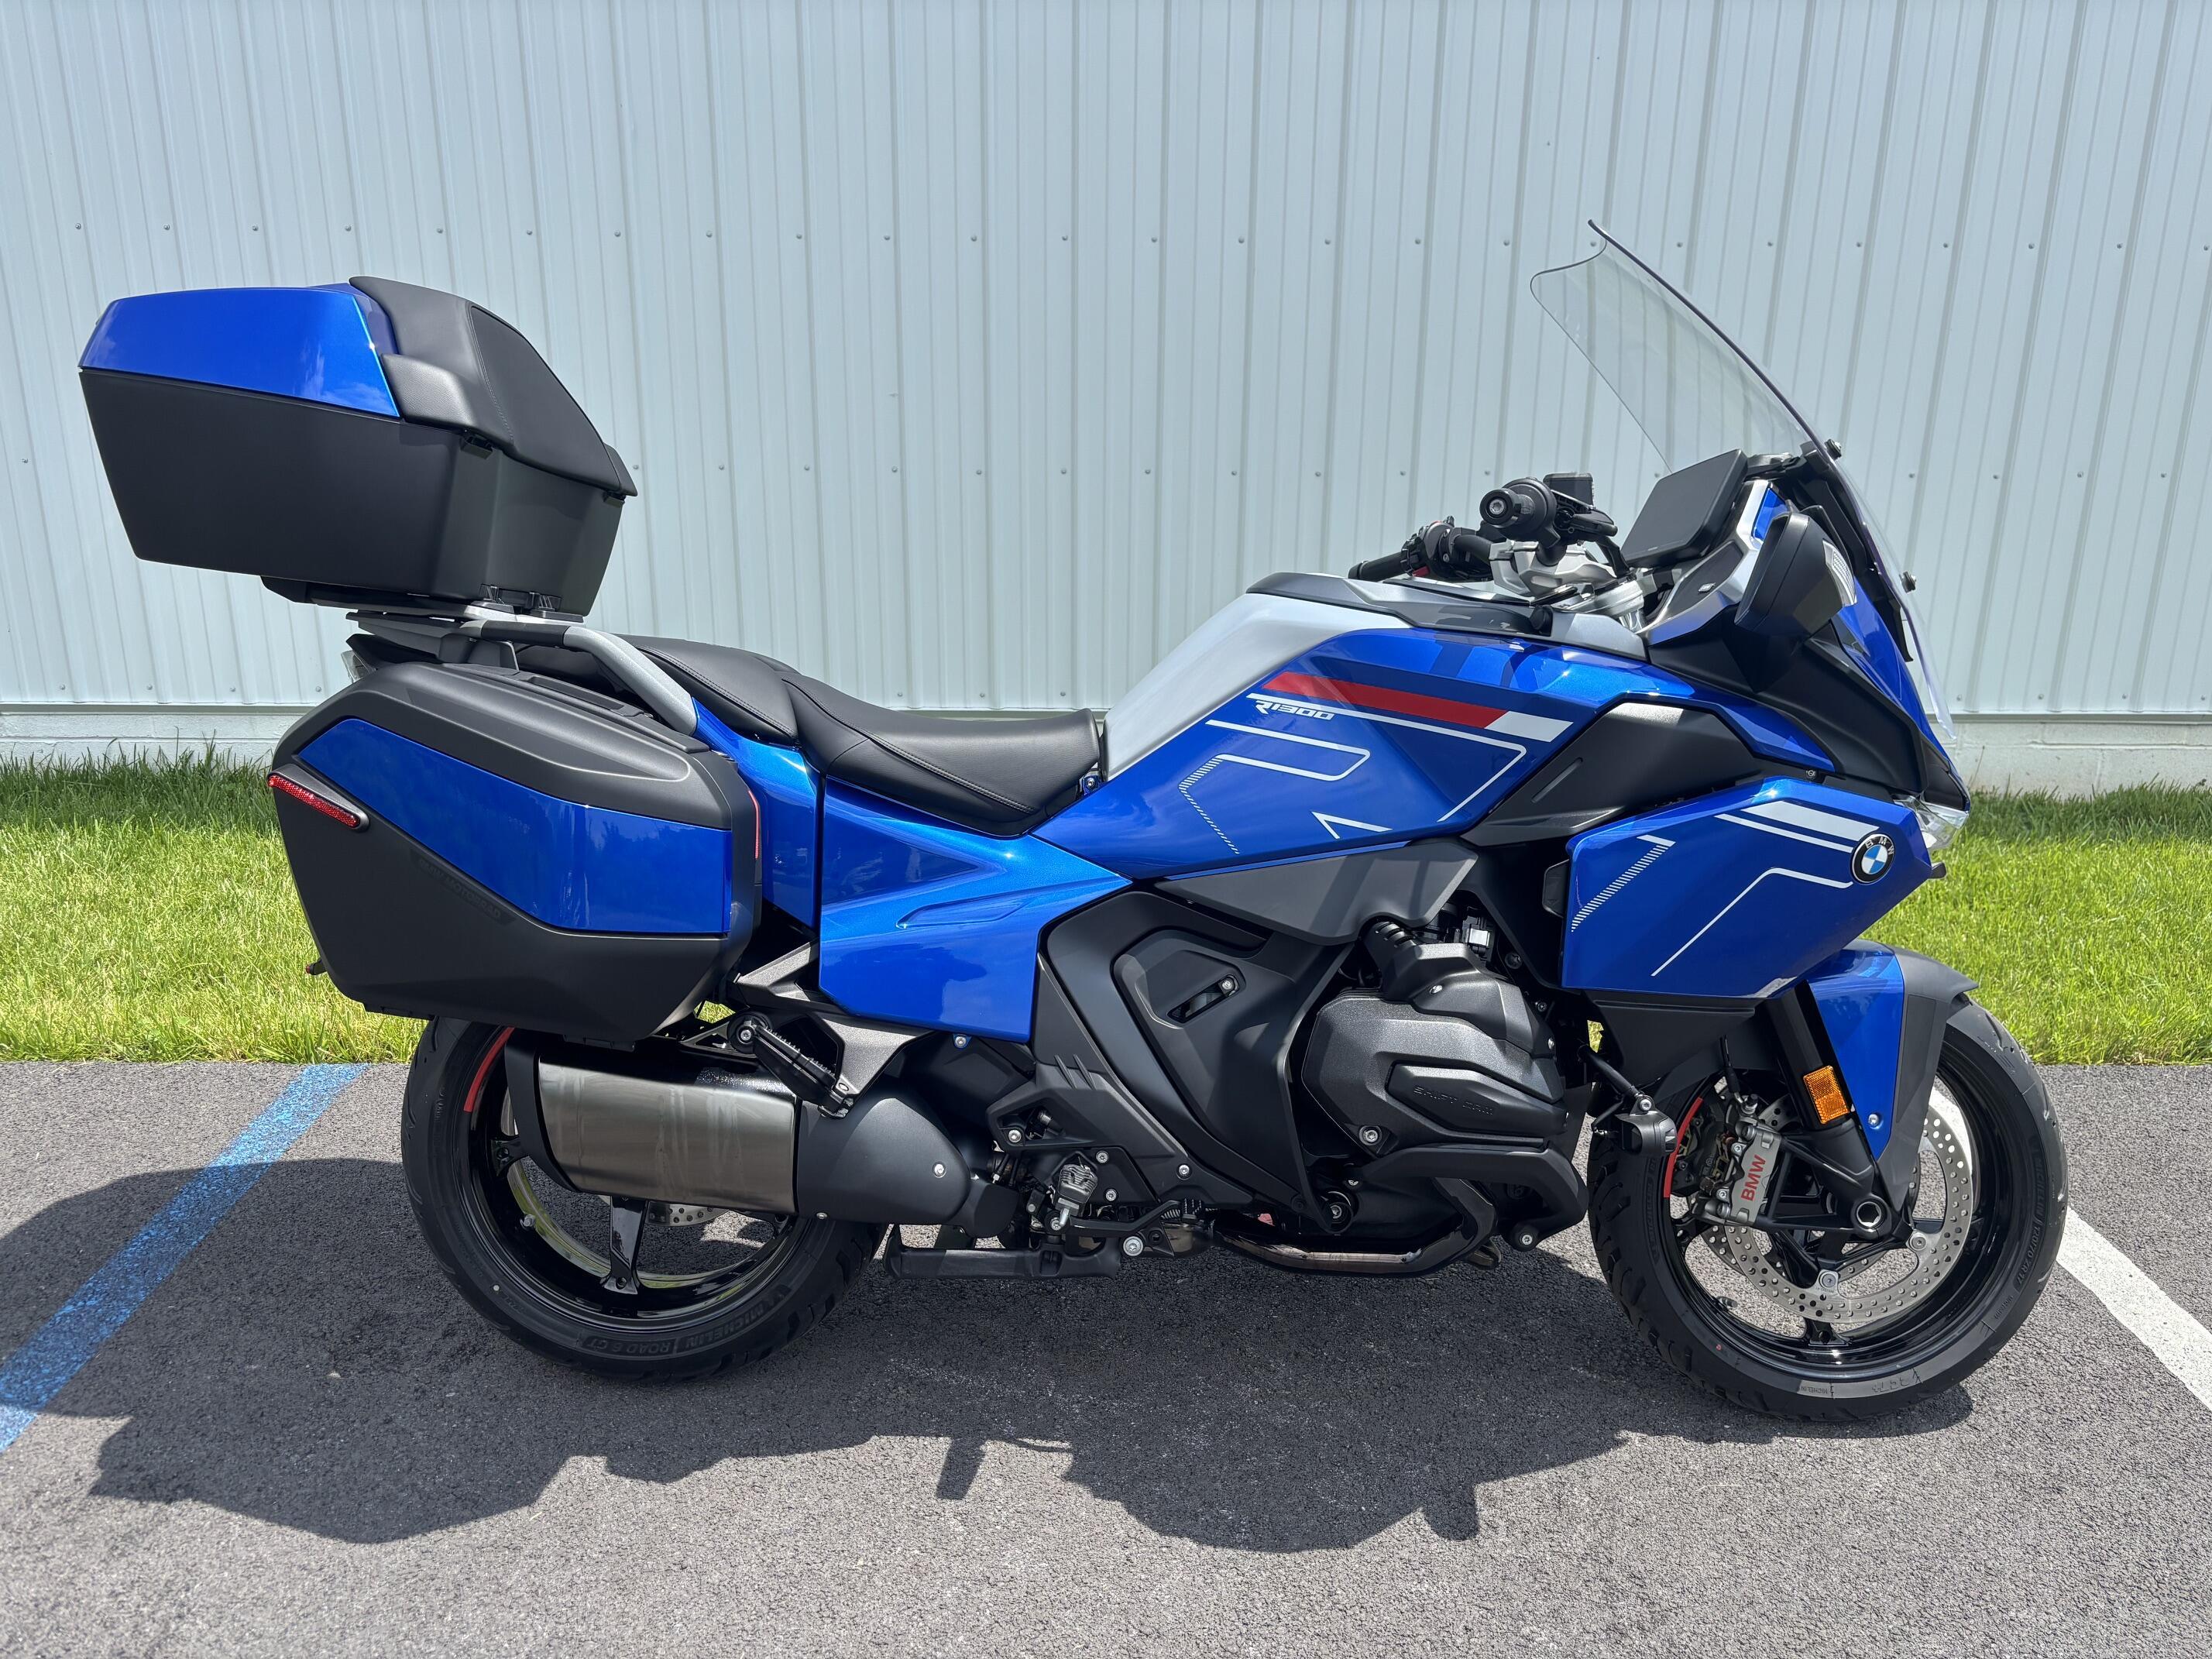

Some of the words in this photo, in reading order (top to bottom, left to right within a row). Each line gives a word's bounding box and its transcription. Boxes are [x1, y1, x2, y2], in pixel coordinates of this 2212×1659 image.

[1865, 836, 1895, 856] BMW
[1740, 1154, 1766, 1201] BMW
[2034, 1157, 2045, 1218] MICHELIN
[628, 1341, 671, 1354] ROAD
[685, 1304, 764, 1350] MICHELIN
